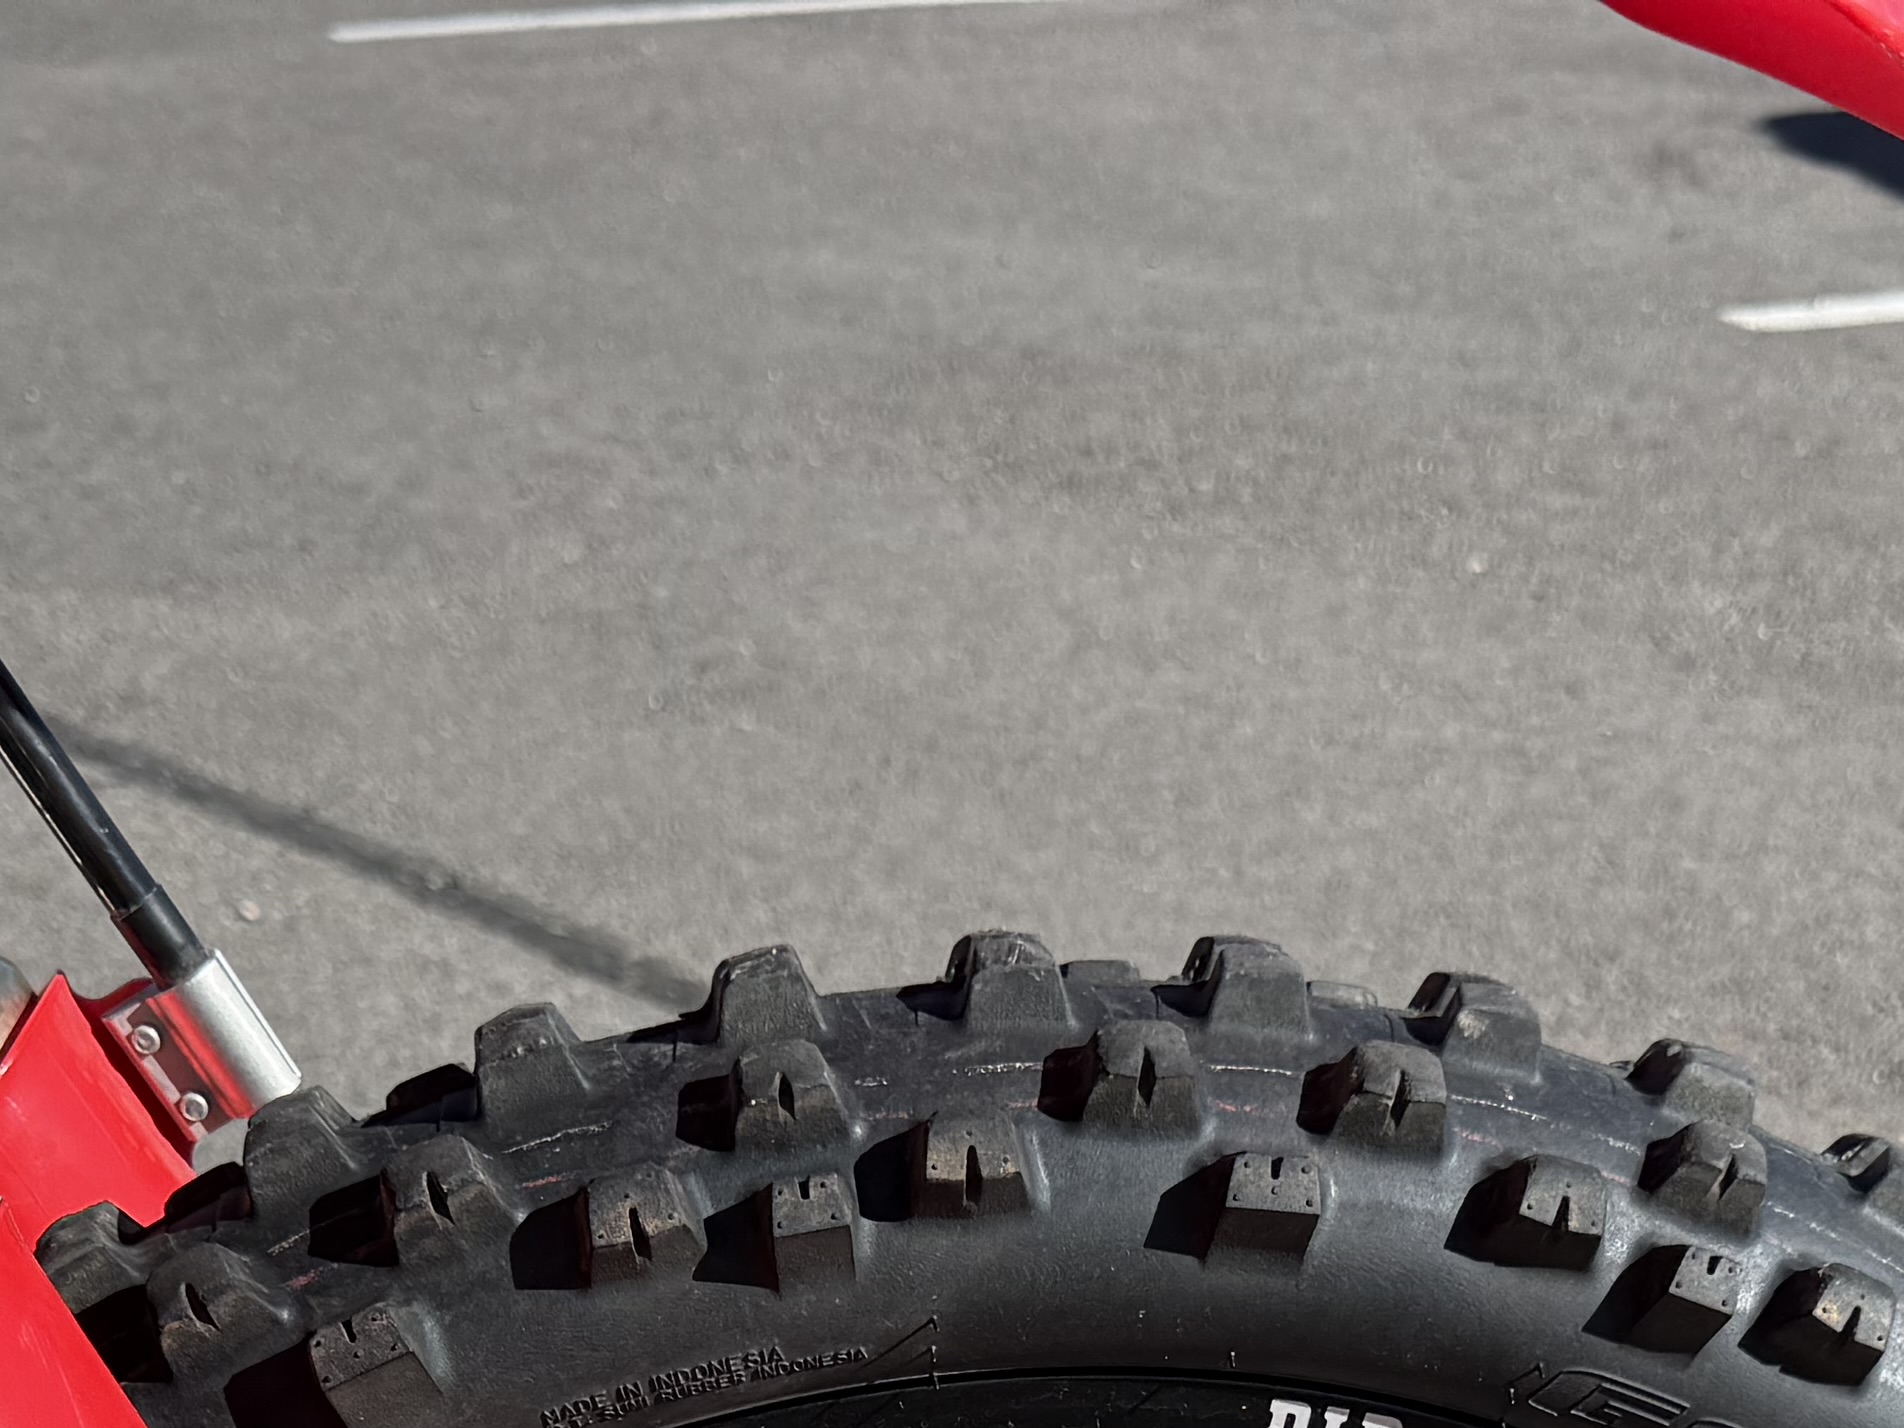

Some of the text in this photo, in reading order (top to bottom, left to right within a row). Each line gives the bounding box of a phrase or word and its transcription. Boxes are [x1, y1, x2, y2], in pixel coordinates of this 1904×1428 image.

[615, 1380, 645, 1404] IN
[648, 1345, 787, 1396] INDONESIA
[751, 1346, 869, 1383] INDONESIA
